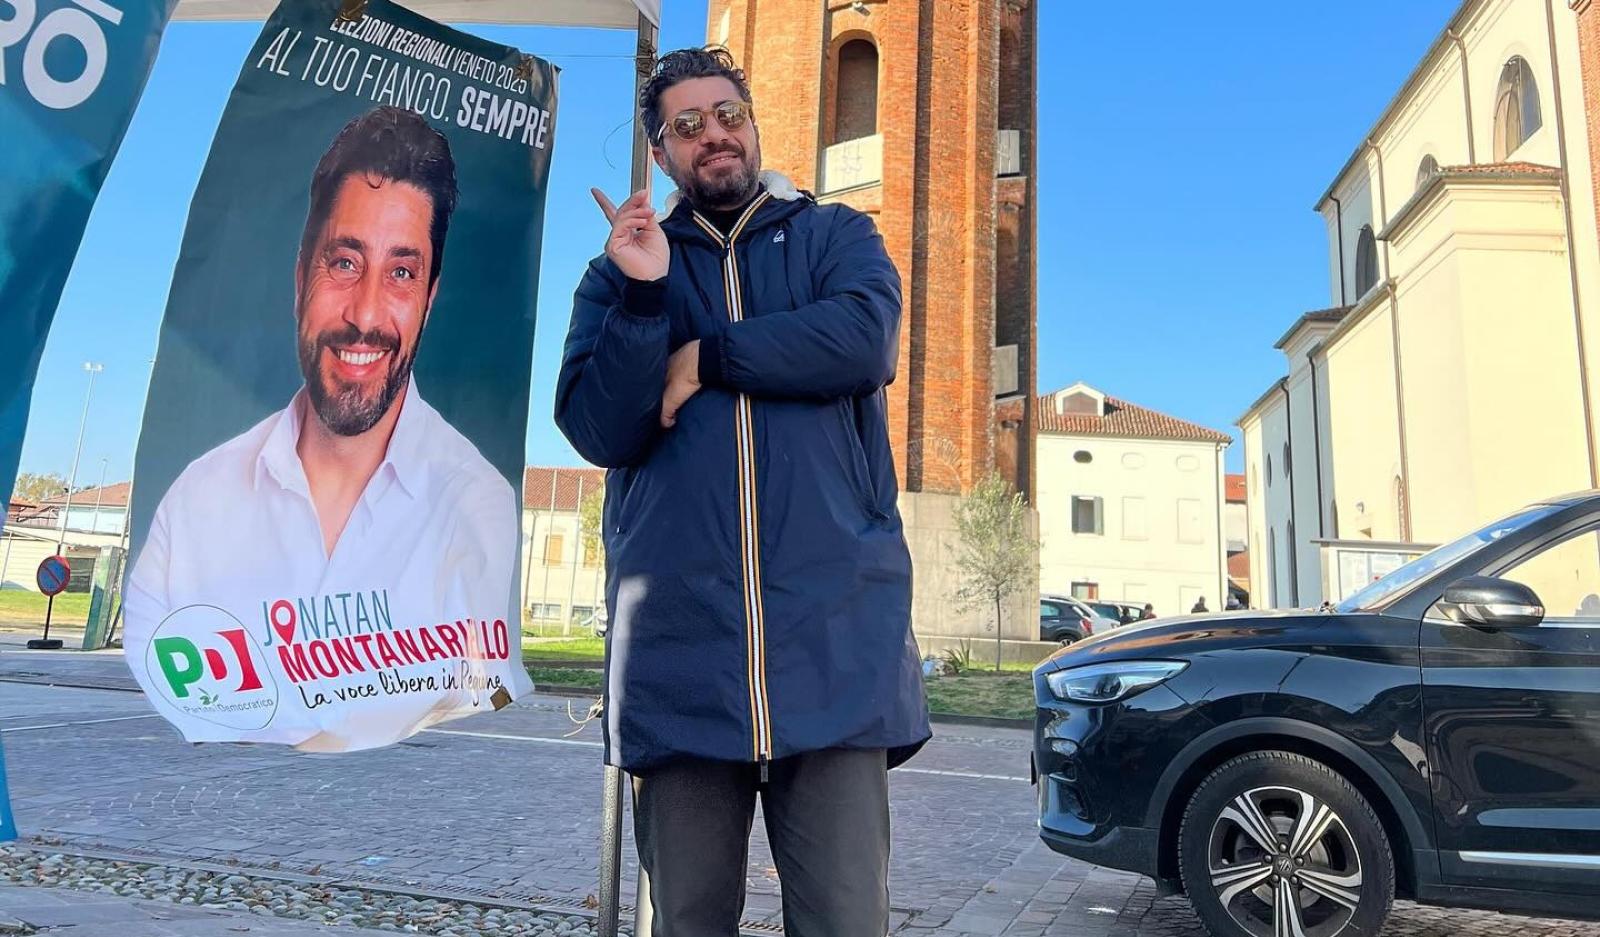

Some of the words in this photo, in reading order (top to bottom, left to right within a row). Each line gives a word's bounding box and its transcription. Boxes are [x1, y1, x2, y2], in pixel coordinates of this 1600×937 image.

[330, 14, 394, 47] ELEZIONI
[387, 27, 454, 69] REGIONALI
[452, 50, 497, 84] VENETO
[496, 64, 527, 94] 2025
[256, 27, 302, 76] AL
[302, 36, 360, 92] TUO
[355, 54, 451, 122] FIANCO.
[456, 86, 550, 149] SEMPRE
[263, 589, 393, 647] JONATAN
[277, 618, 509, 683] MONTANARILO
[217, 698, 274, 713] Democratico
[334, 683, 379, 701] voce
[378, 668, 440, 695] libera
[442, 667, 459, 690] in
[461, 660, 503, 707] Regne
